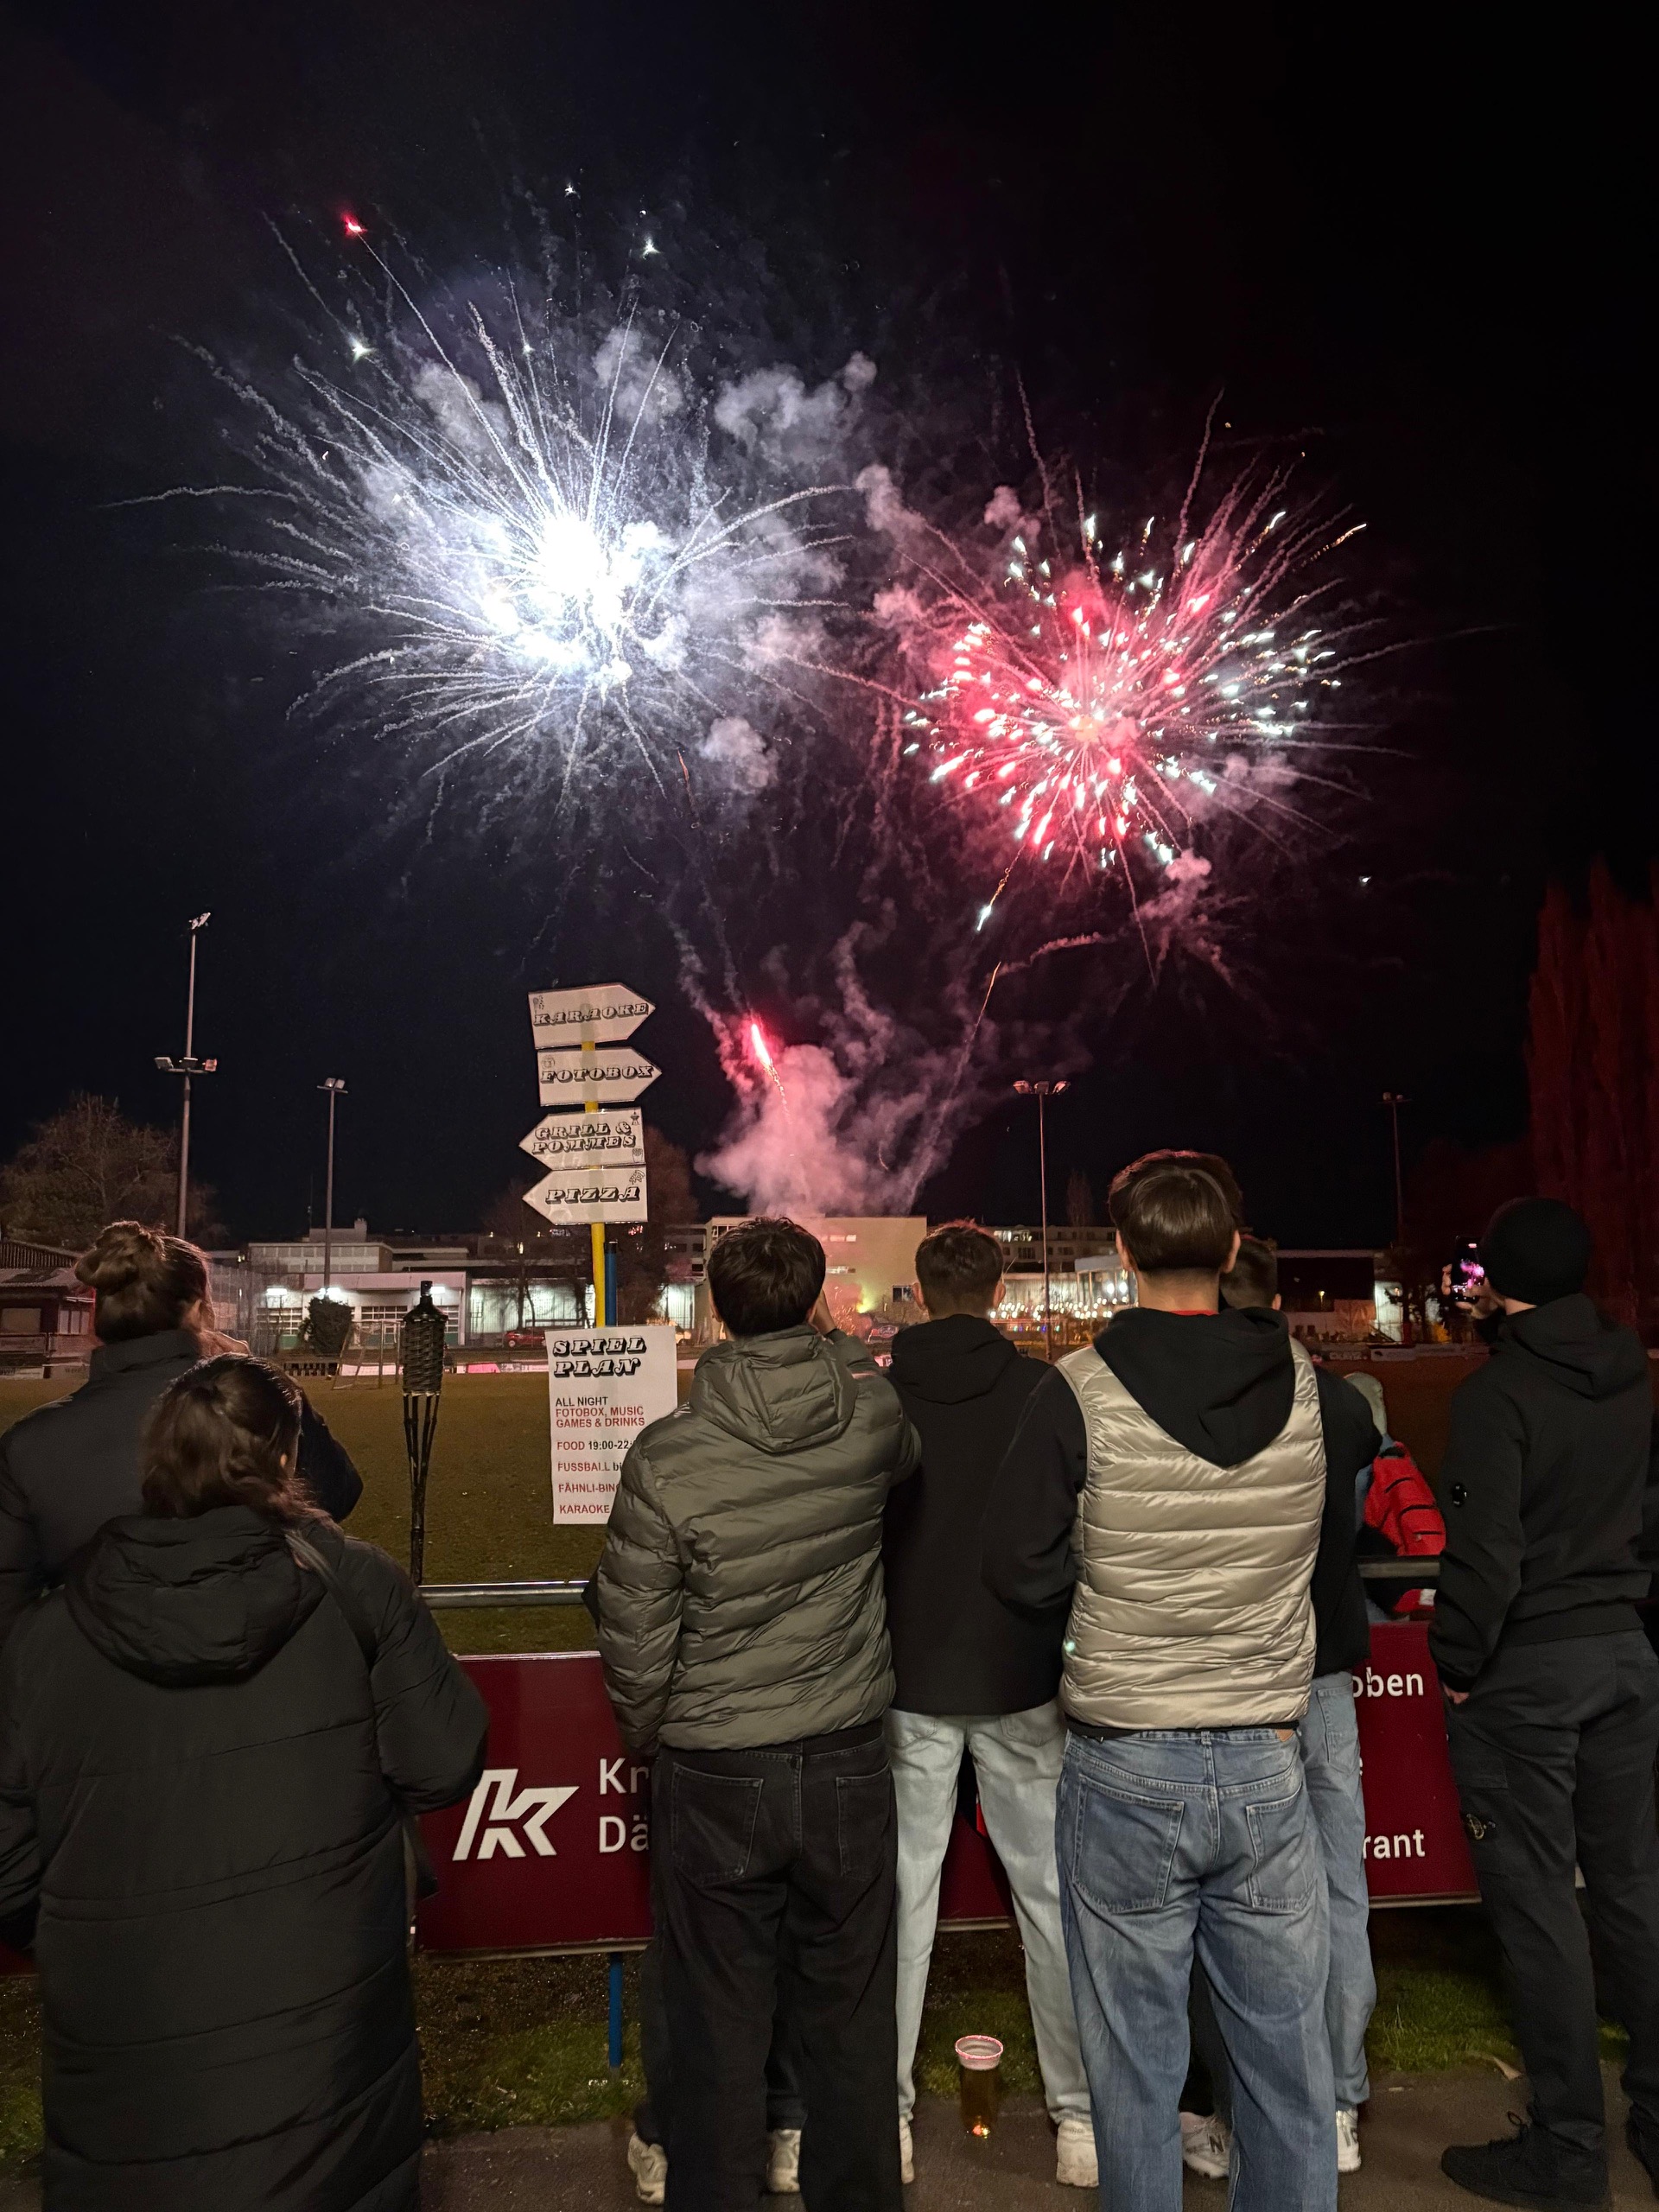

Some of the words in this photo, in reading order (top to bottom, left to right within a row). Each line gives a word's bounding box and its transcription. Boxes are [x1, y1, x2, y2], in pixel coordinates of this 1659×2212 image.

[533, 1003, 649, 1026] KARAOKE
[540, 1065, 654, 1084] FOTOBOX
[534, 1123, 611, 1140] GRILL
[615, 1122, 632, 1135] &
[531, 1135, 636, 1154] POMMES
[545, 1186, 640, 1204] PIZZA
[552, 1338, 646, 1357] SPIEL
[554, 1358, 640, 1377] PLAN
[556, 1397, 575, 1407] ALL
[577, 1396, 608, 1406] NIGHT
[556, 1407, 607, 1418] FOTOBOX,
[610, 1406, 644, 1416] MUSIC
[556, 1419, 592, 1428] GAMES
[594, 1418, 601, 1427] &
[605, 1417, 645, 1427] DRINKS
[556, 1441, 585, 1451] FOOD
[588, 1440, 636, 1450] 19:00-22:
[557, 1462, 610, 1471] FUSSBALL
[559, 1504, 610, 1514] KARAOKE
